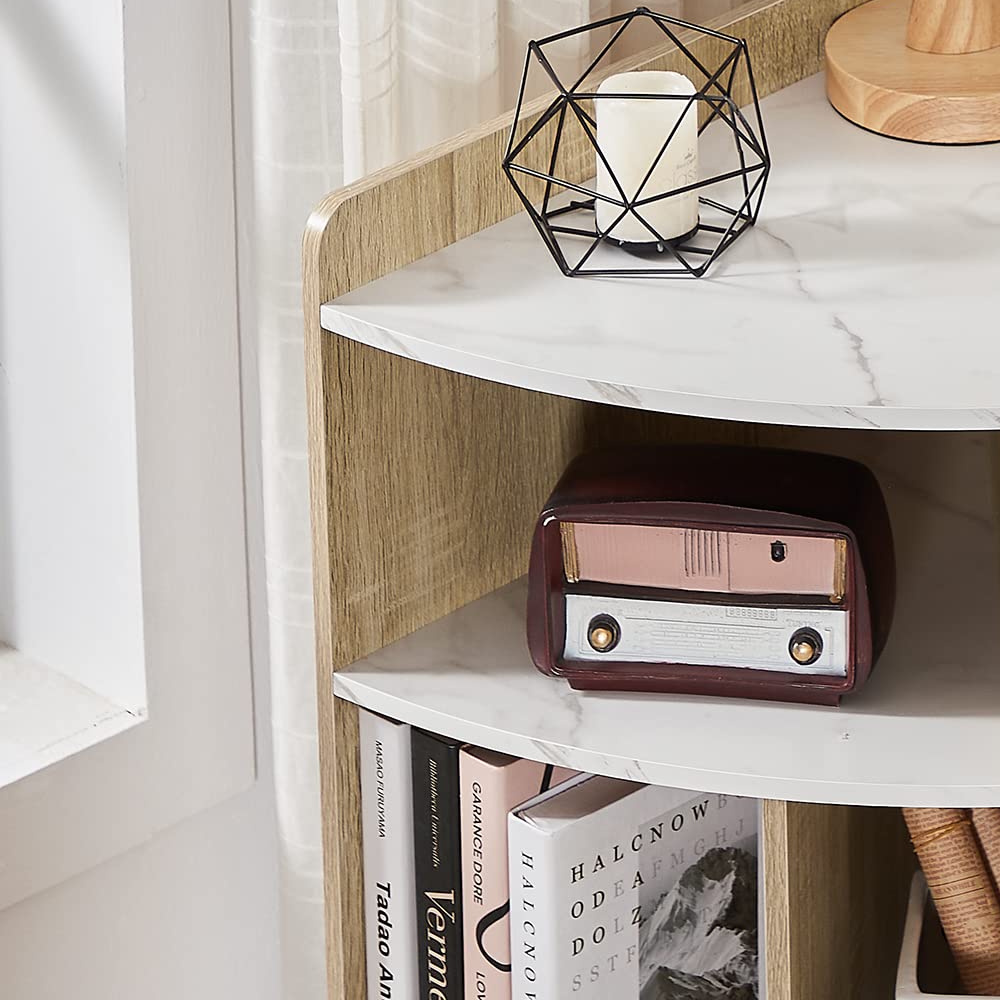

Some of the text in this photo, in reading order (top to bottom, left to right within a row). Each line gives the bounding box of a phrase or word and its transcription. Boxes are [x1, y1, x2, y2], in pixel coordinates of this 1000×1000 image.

[375, 740, 386, 838] MASAO FURUYAMA
[472, 781, 483, 905] GARANCE DORE
[376, 882, 394, 1000] Tadao An
[571, 905, 644, 957] DOLZ
[571, 944, 637, 992] SSTF
